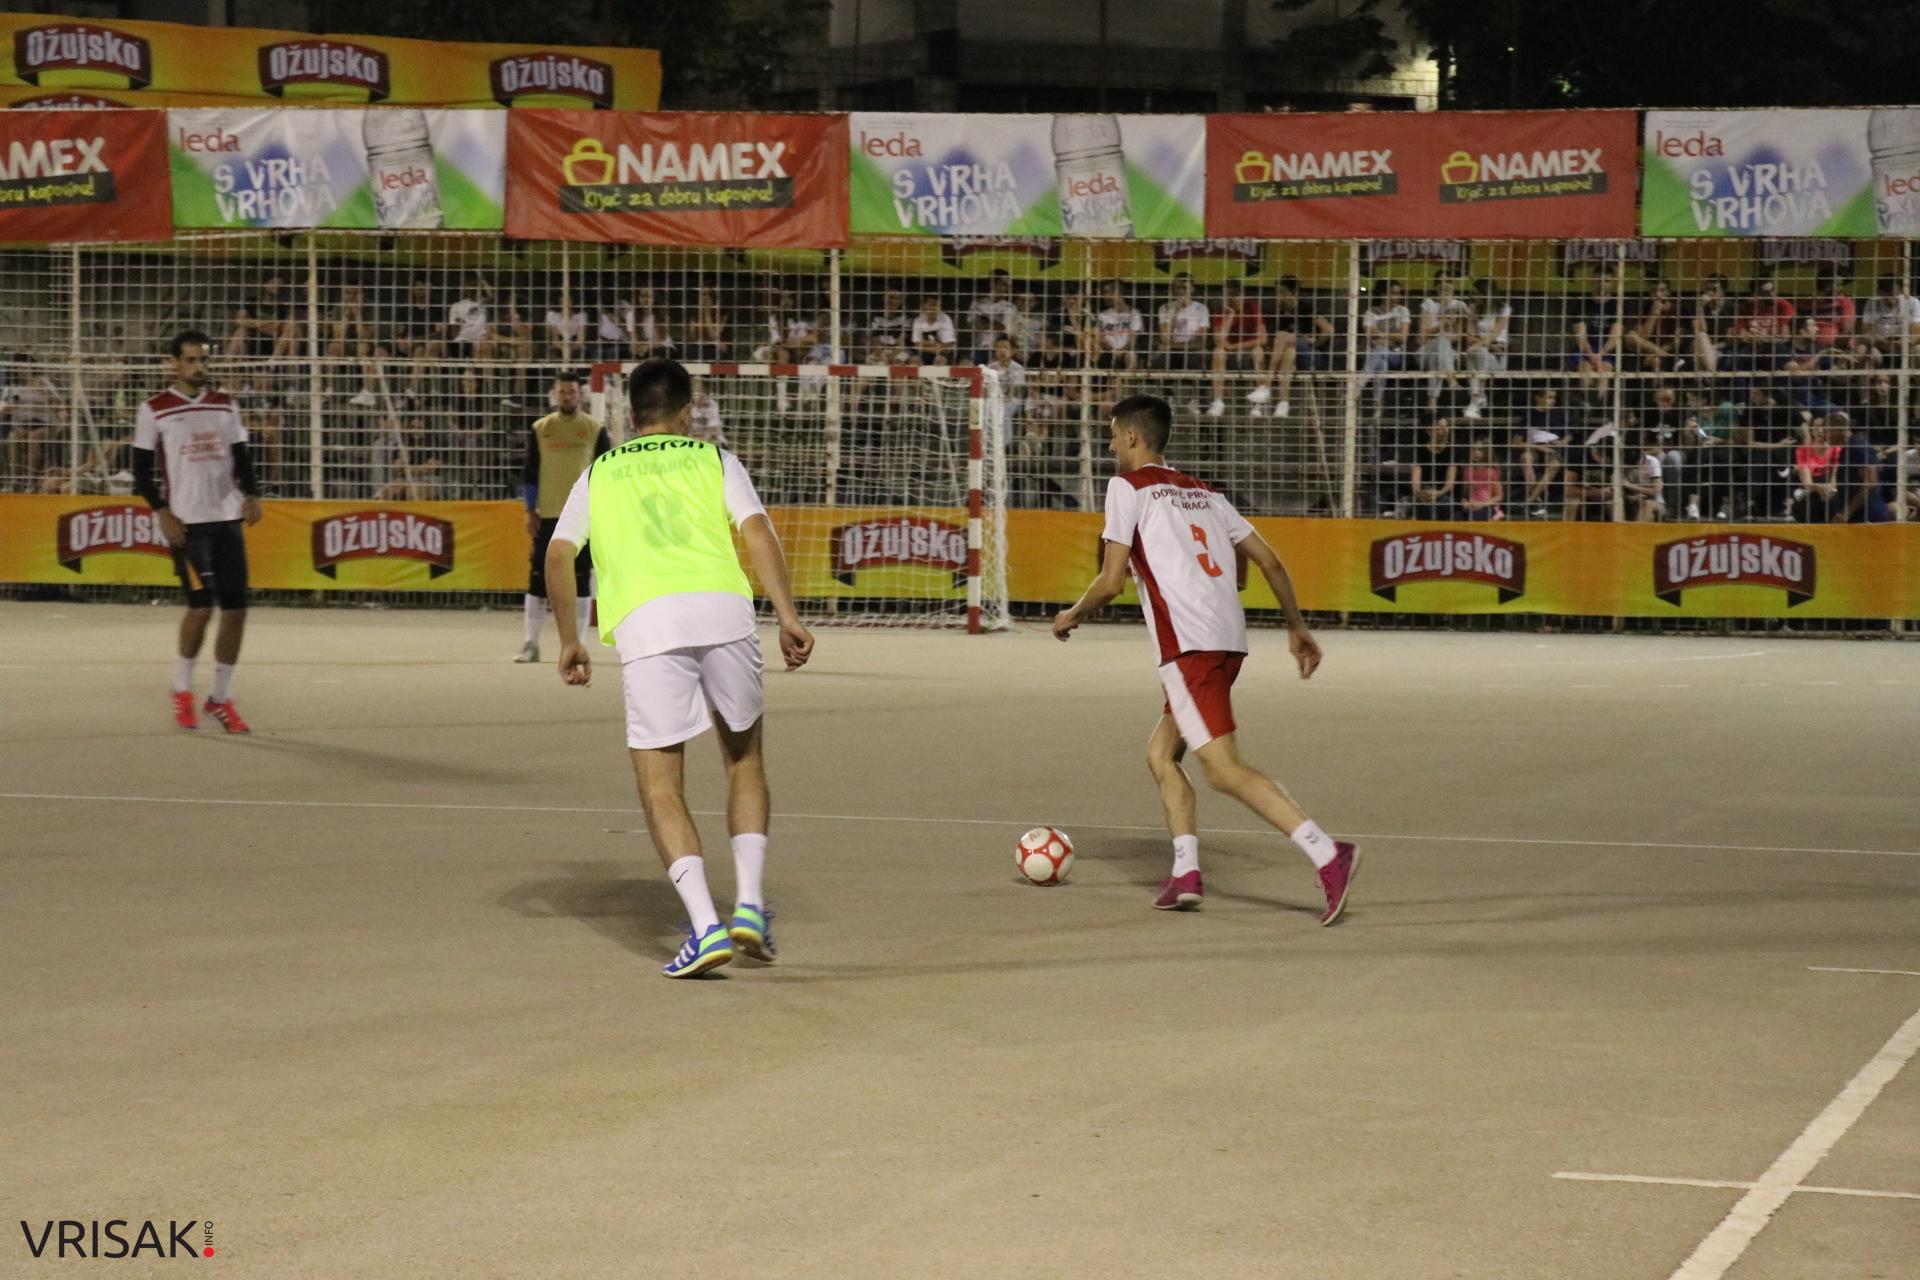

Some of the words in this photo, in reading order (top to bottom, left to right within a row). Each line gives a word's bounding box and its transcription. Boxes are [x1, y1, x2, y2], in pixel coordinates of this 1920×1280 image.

[26, 28, 140, 70] Ožujsko
[270, 42, 379, 83] Ožujsko
[501, 56, 605, 94] Ožujsko
[0, 137, 108, 179] MEX
[180, 128, 241, 153] leda
[860, 130, 923, 157] leda
[1656, 131, 1724, 157] leda
[214, 164, 235, 193] S
[380, 165, 429, 190] leda
[617, 142, 786, 184] NAMEX
[1272, 149, 1393, 181] NAMEX
[1480, 148, 1603, 182] NAMEX
[215, 183, 340, 223] VRHOVA
[628, 192, 654, 206] za
[892, 169, 915, 199] S
[1067, 172, 1119, 198] leda
[1690, 169, 1714, 201] S
[893, 191, 1022, 229] VRHOVA
[1690, 191, 1833, 231] VRHOVA
[601, 439, 704, 462] macron
[69, 508, 170, 551] Ožujsk
[323, 508, 444, 557] Ožujsko
[844, 519, 967, 565] Ožujsko
[1383, 532, 1513, 580] Ožujsko
[1667, 535, 1803, 583] Ožujsko
